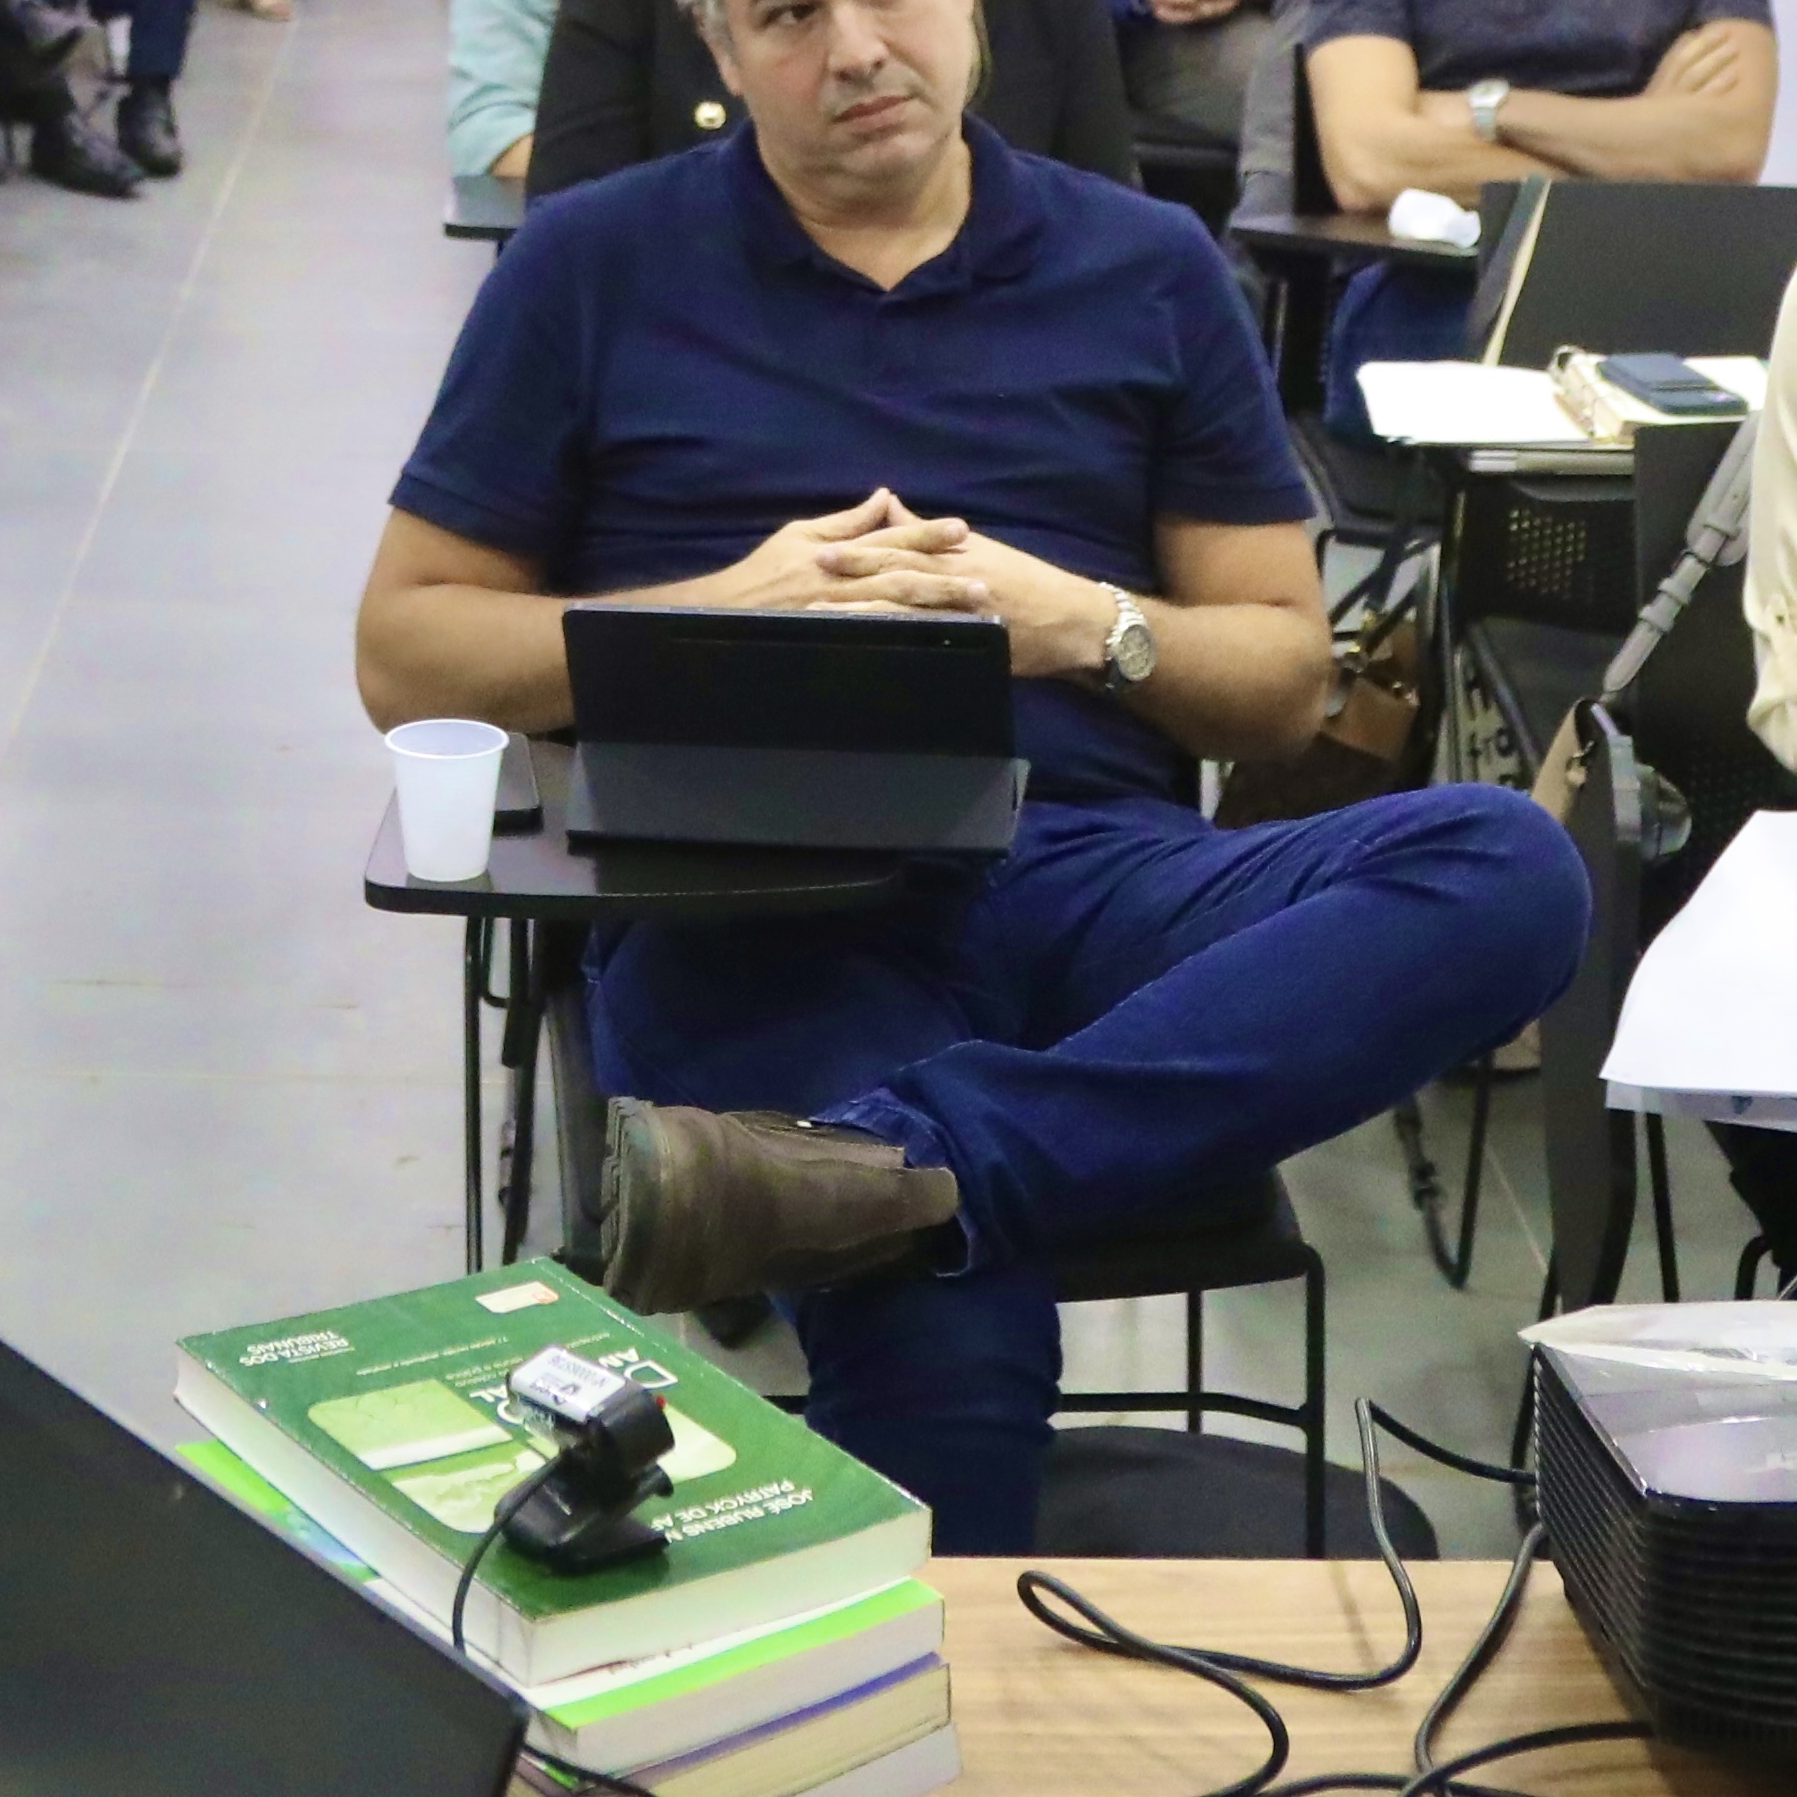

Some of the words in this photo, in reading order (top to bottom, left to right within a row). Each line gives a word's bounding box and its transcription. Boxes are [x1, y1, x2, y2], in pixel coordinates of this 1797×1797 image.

[247, 1330, 340, 1355] TRIBUNAIS
[277, 1338, 349, 1358] REVISTA
[238, 1351, 279, 1367] DOS
[704, 1478, 796, 1515] PATRYCK
[762, 1486, 814, 1516] JOSÉ
[674, 1505, 708, 1524] DE
[681, 1506, 765, 1538] RUBENS
